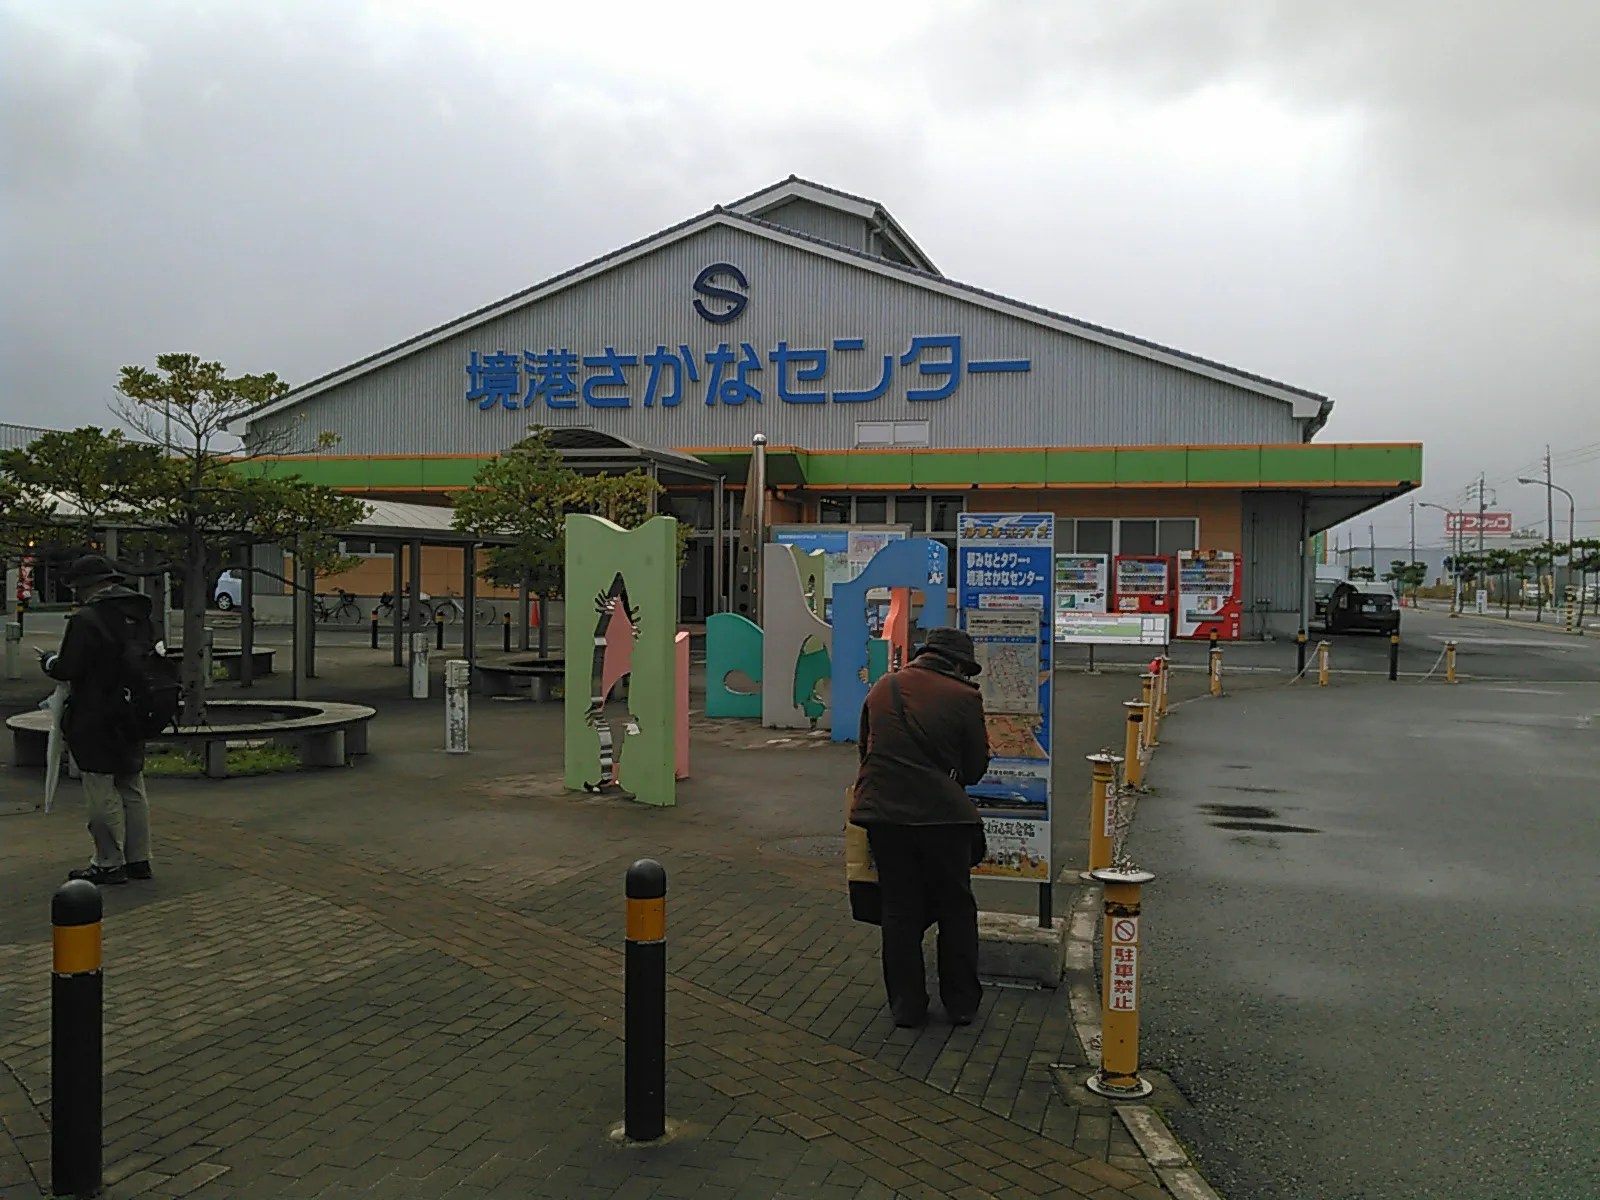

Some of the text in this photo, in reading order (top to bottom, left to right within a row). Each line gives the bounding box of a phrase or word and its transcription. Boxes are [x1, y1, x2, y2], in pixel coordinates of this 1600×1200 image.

[466, 335, 1031, 410] 境港さかなセンター
[966, 570, 1045, 587] 境港さかなセンター
[1113, 948, 1135, 1010] 駐車禁止
